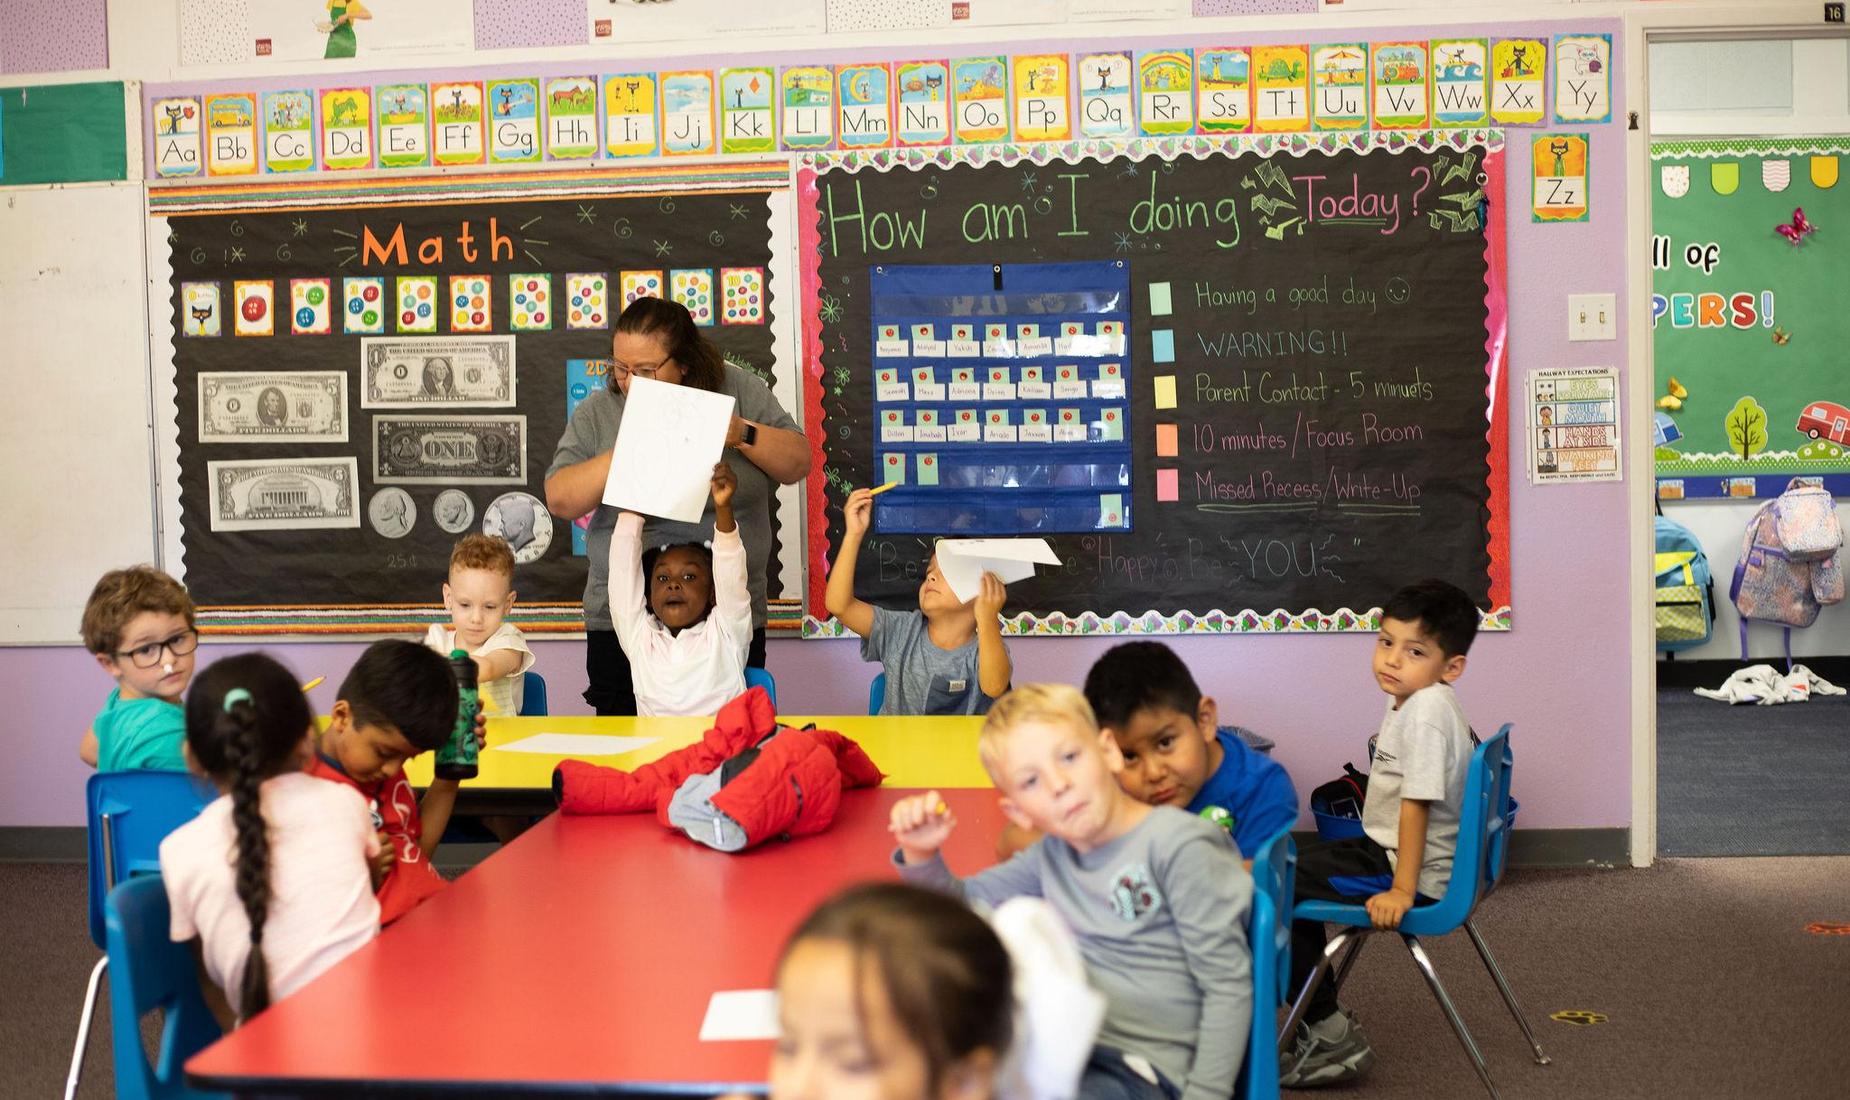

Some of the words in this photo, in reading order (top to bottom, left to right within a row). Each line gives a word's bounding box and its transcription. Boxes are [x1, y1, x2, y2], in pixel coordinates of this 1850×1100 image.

[1828, 7, 1841, 20] 16
[1153, 94, 1180, 119] Rr
[1211, 93, 1237, 117] Ss
[1266, 90, 1297, 115] Tt
[1324, 89, 1357, 114] Uu
[1386, 87, 1415, 112] Vv
[1437, 84, 1482, 109] Ww
[1502, 83, 1534, 109] Xx
[1568, 80, 1597, 114] Yy
[732, 112, 763, 137] Kk
[796, 109, 818, 133] Ll
[843, 108, 886, 132] Mm
[906, 105, 938, 129] Nn
[964, 102, 999, 127] Oo
[1027, 100, 1056, 132] Pp
[1086, 98, 1127, 131] Qq
[389, 128, 416, 152] Ee
[443, 125, 472, 149] Ff
[498, 123, 534, 156] Gg
[557, 120, 588, 143] Hh
[623, 117, 639, 141] Ii
[674, 115, 702, 149] Jj
[162, 140, 196, 163] Aa
[217, 136, 247, 160] Bb
[274, 134, 304, 157] Cc
[331, 130, 363, 155] Dd
[1546, 179, 1574, 205] Zz
[827, 180, 926, 257] How
[962, 203, 1029, 243] am
[1057, 174, 1089, 237] I
[1129, 170, 1240, 248] doing
[362, 217, 513, 265] Math
[1686, 245, 1718, 272] of
[727, 275, 741, 286] 10
[1195, 281, 1256, 315] Having
[1265, 287, 1276, 303] a
[1289, 274, 1329, 312] good
[1342, 277, 1377, 314] day
[1197, 329, 1348, 358] WARNING!!
[1195, 370, 1251, 403] Parent
[1259, 371, 1327, 403] Contact
[1350, 371, 1365, 398] 5
[1570, 379, 1598, 391] EYES
[1565, 412, 1606, 424] MOUTH
[1568, 402, 1601, 413] QUIET
[1192, 423, 1215, 453] 10
[1221, 421, 1287, 451] minutes
[1305, 419, 1355, 449] Focus
[1362, 412, 1424, 447] Room
[1564, 437, 1581, 448] AT
[1583, 436, 1607, 447] SIDE
[1565, 426, 1606, 437] HANDS
[424, 440, 475, 460] ONE
[1559, 450, 1614, 463] WALKING
[1195, 470, 1256, 500] Missed
[1241, 539, 1317, 579] YOU
